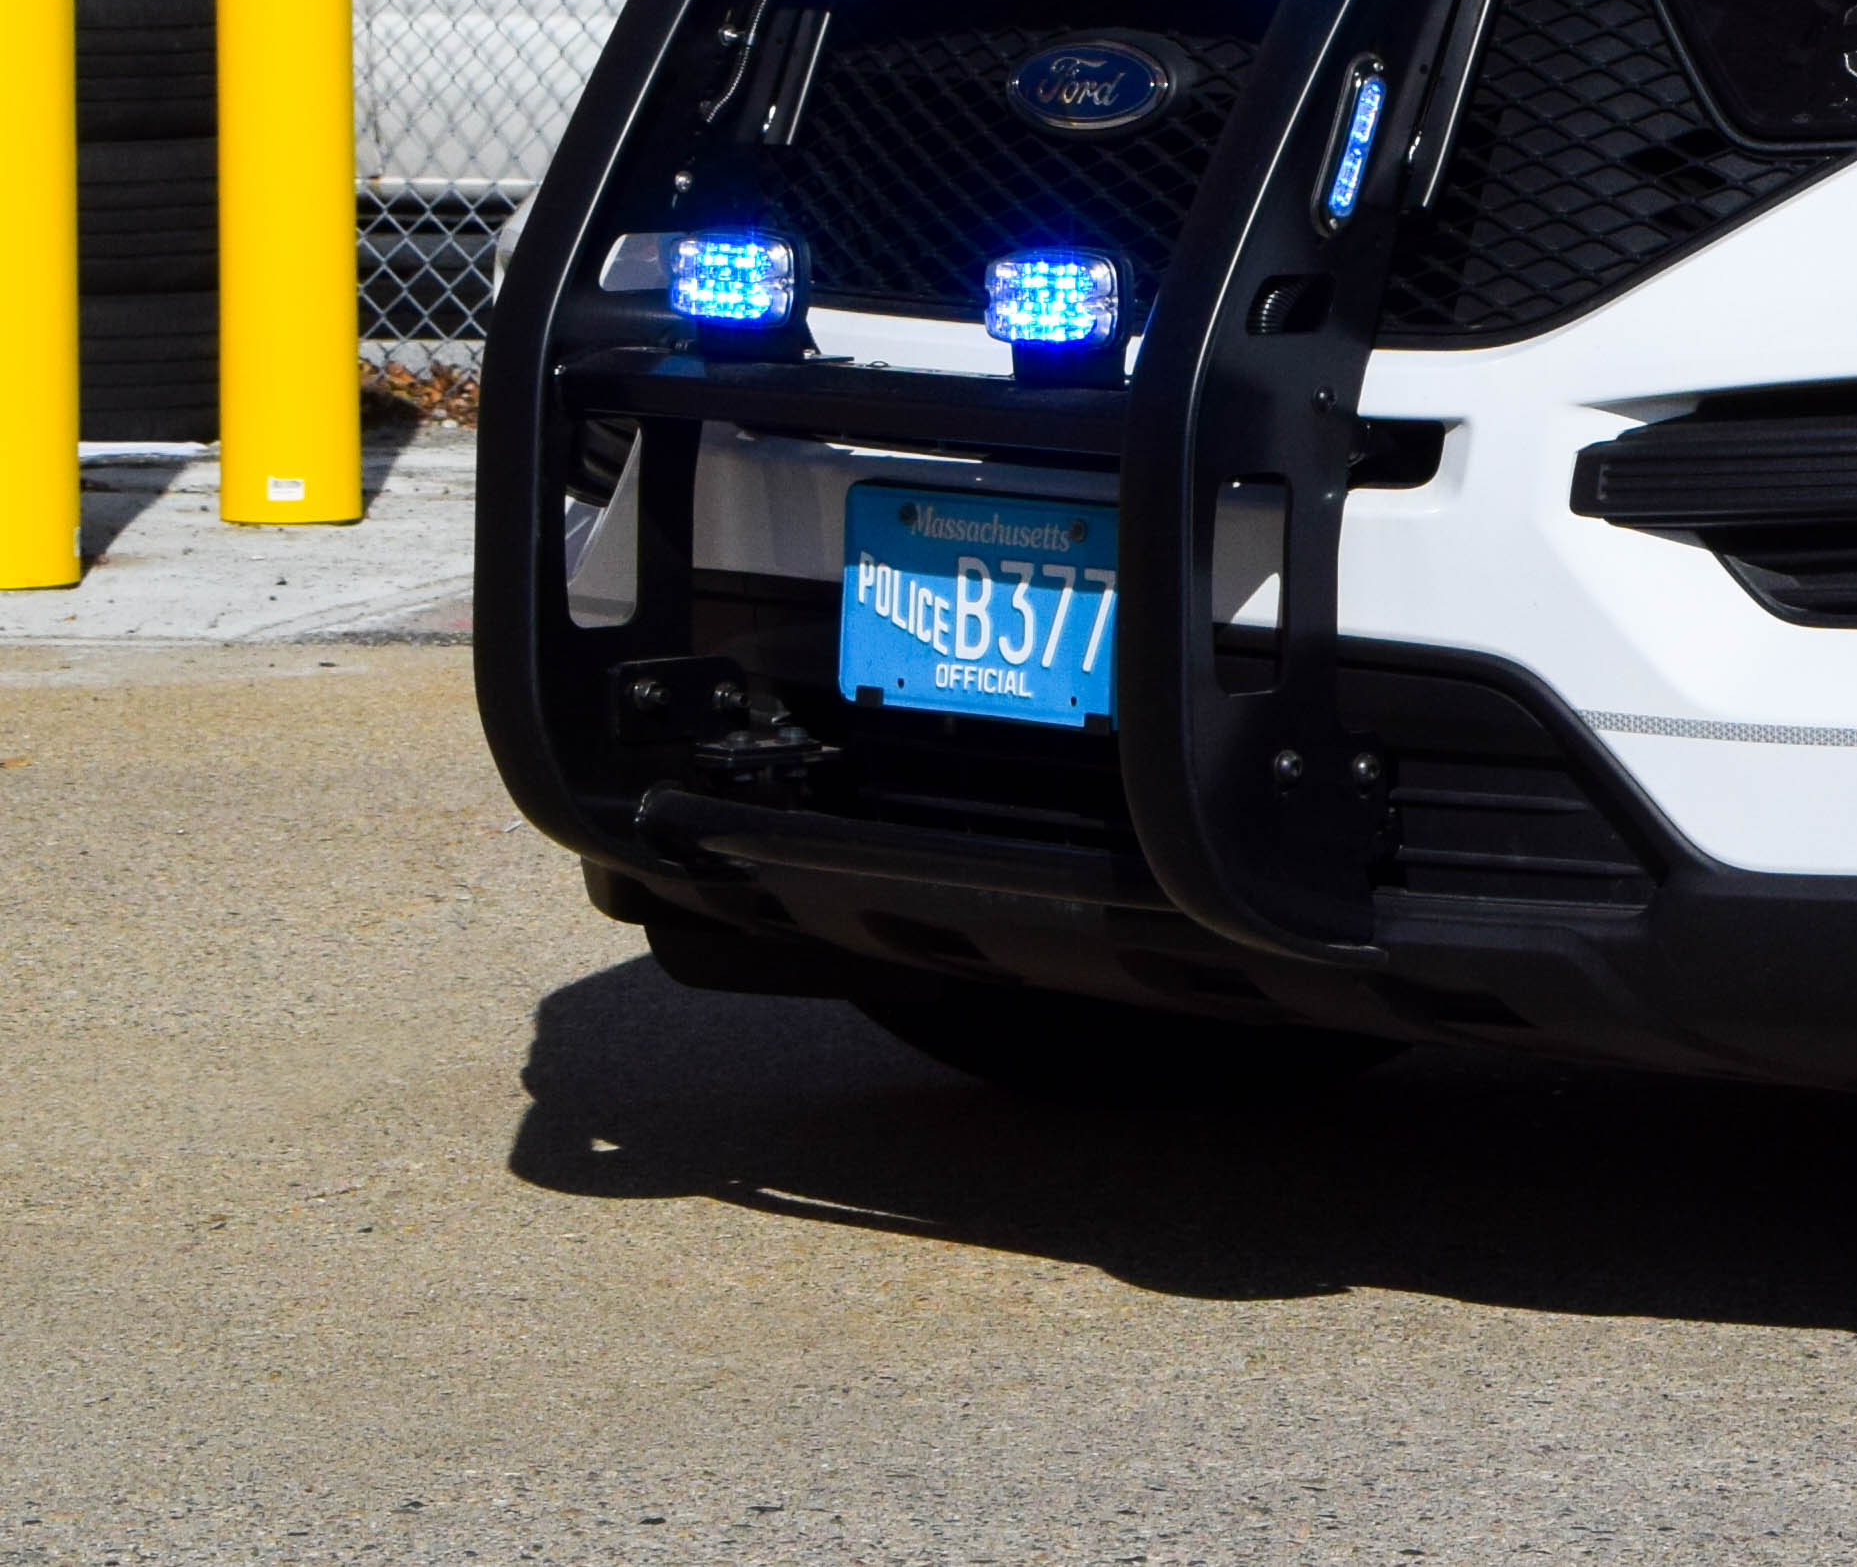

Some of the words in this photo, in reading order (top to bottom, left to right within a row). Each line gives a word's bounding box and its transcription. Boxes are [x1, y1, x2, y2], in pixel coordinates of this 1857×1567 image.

[1036, 56, 1126, 106] Ford
[908, 503, 1071, 552] Massachusetts
[857, 550, 951, 657] POLICE
[954, 556, 1117, 674] B377
[935, 663, 1033, 698] OFFICIAL
